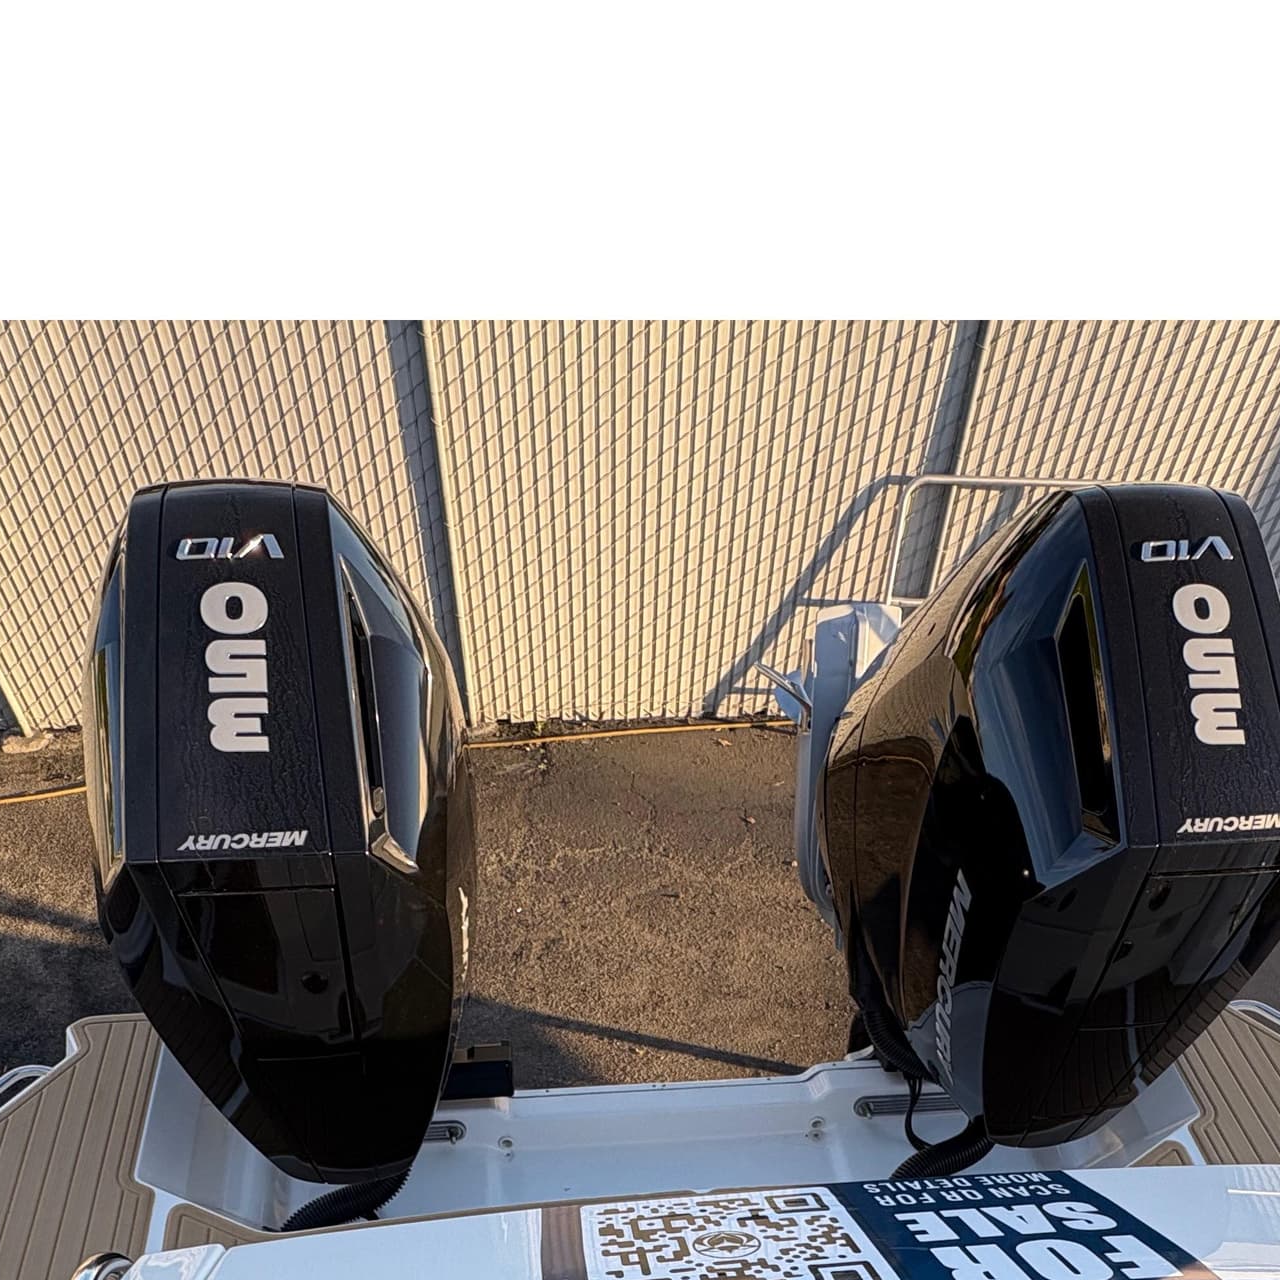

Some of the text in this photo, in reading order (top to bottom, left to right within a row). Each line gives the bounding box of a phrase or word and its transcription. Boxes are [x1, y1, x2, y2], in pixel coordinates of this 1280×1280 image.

[176, 533, 285, 561] V10
[1140, 535, 1234, 562] V10
[200, 581, 270, 753] 350
[1172, 583, 1246, 745] 350
[176, 830, 309, 851] MERCURY
[935, 867, 973, 1086] MERCURY
[863, 1171, 1052, 1194] MORE DETAILS
[874, 1183, 1071, 1207] SCAN QR FOR
[893, 1201, 1118, 1243] SALE
